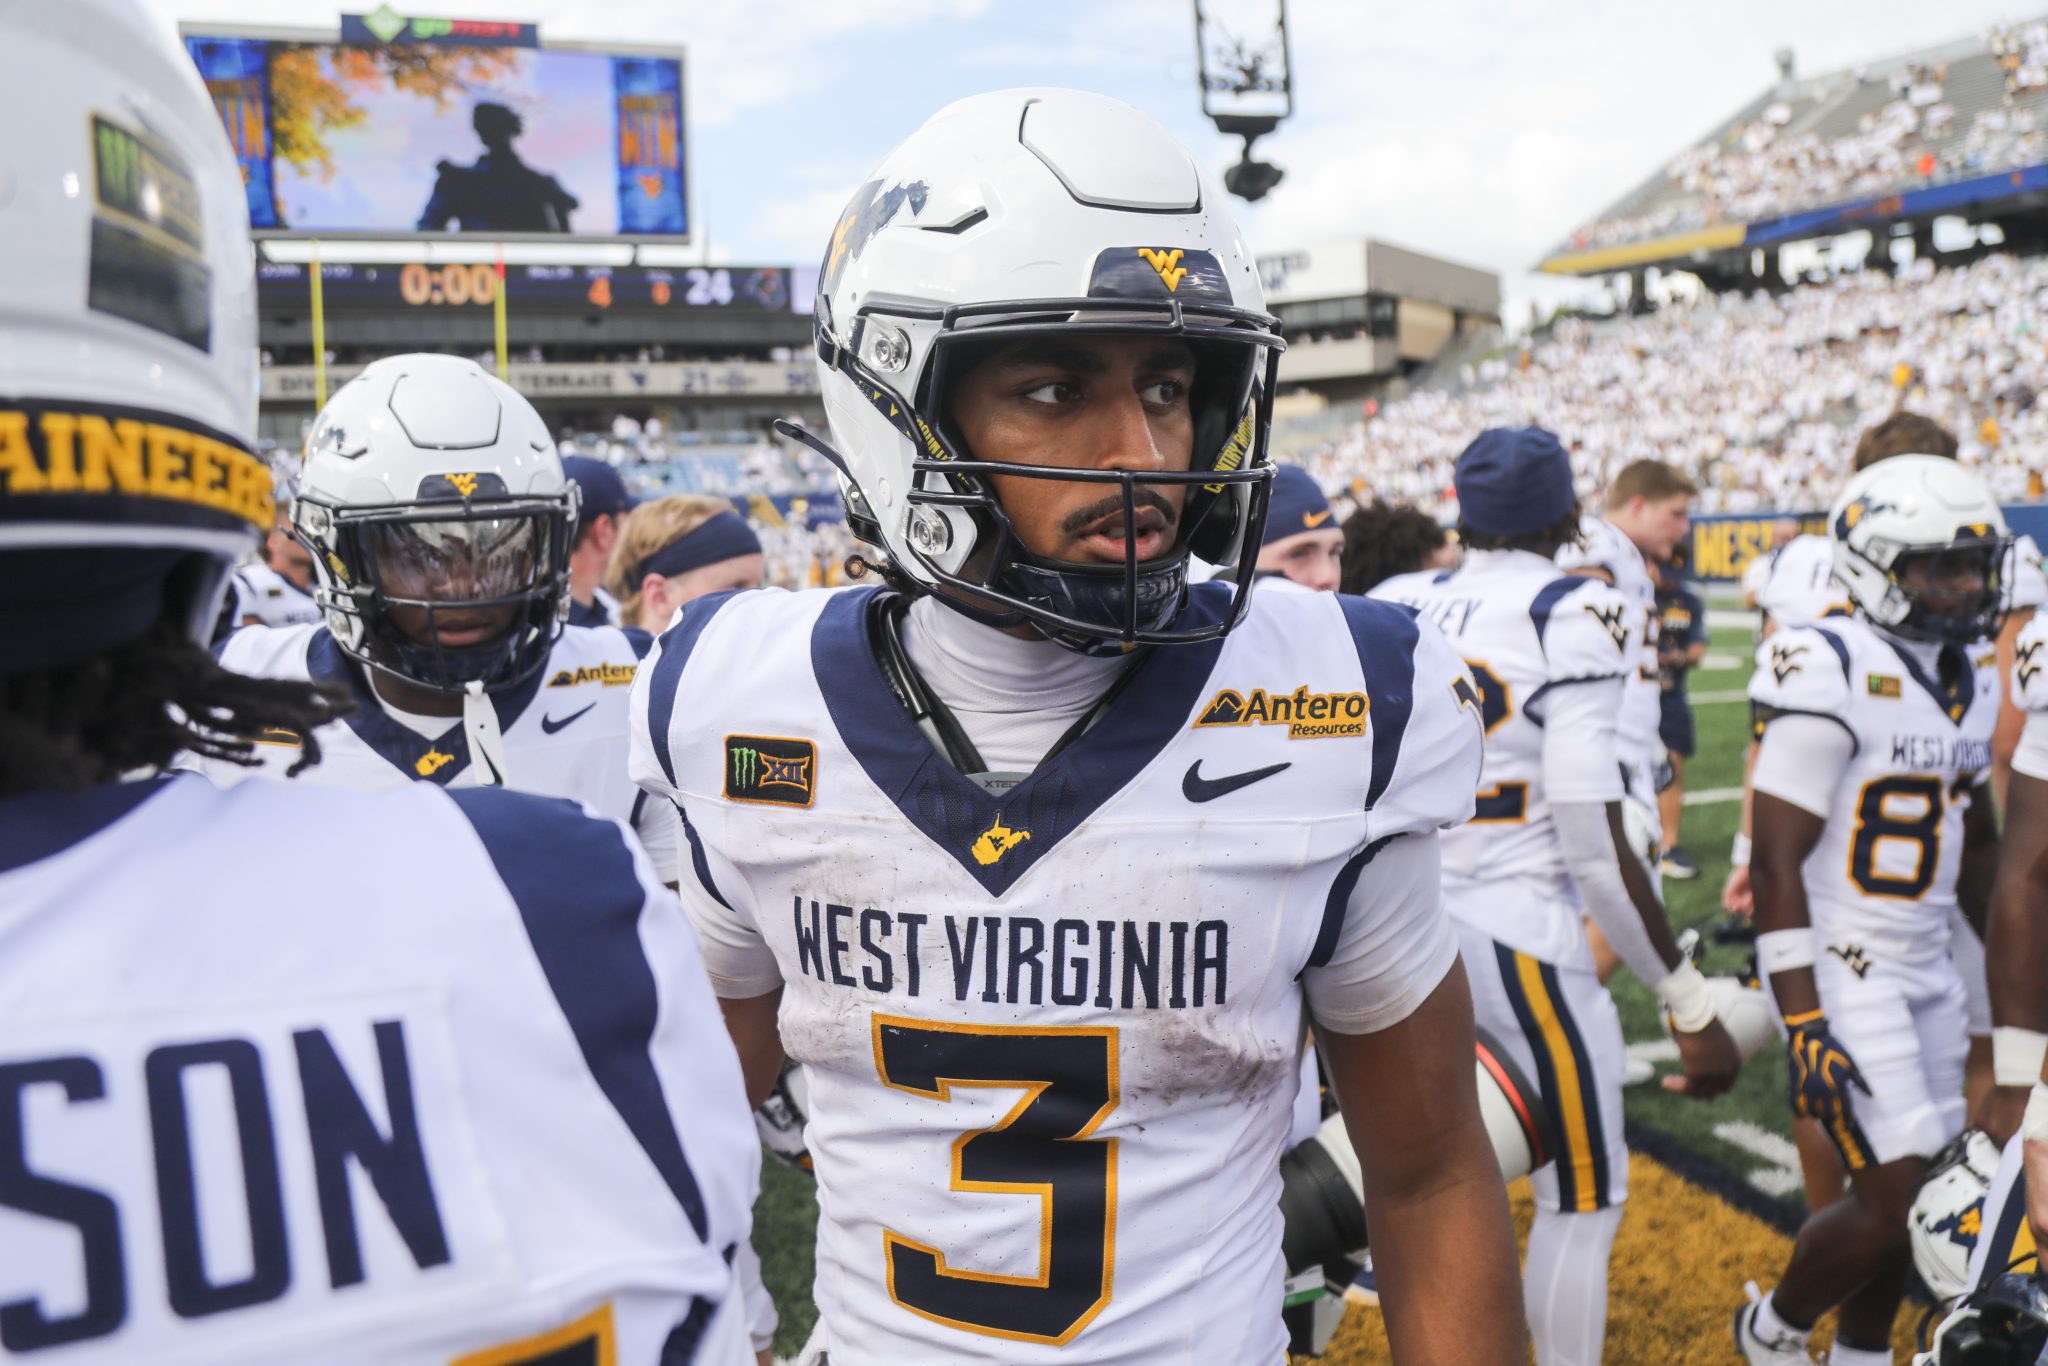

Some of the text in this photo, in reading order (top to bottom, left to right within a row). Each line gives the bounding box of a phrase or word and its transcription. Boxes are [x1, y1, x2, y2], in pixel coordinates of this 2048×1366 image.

[401, 262, 496, 305] 0:00
[588, 277, 612, 309] 4
[685, 268, 735, 306] 24
[1243, 689, 1366, 721] Antero
[1291, 722, 1362, 736] Resources
[793, 896, 1229, 1010] WEST VIRGINIA
[0, 1020, 451, 1354] SON
[871, 1011, 1121, 1347] 3
